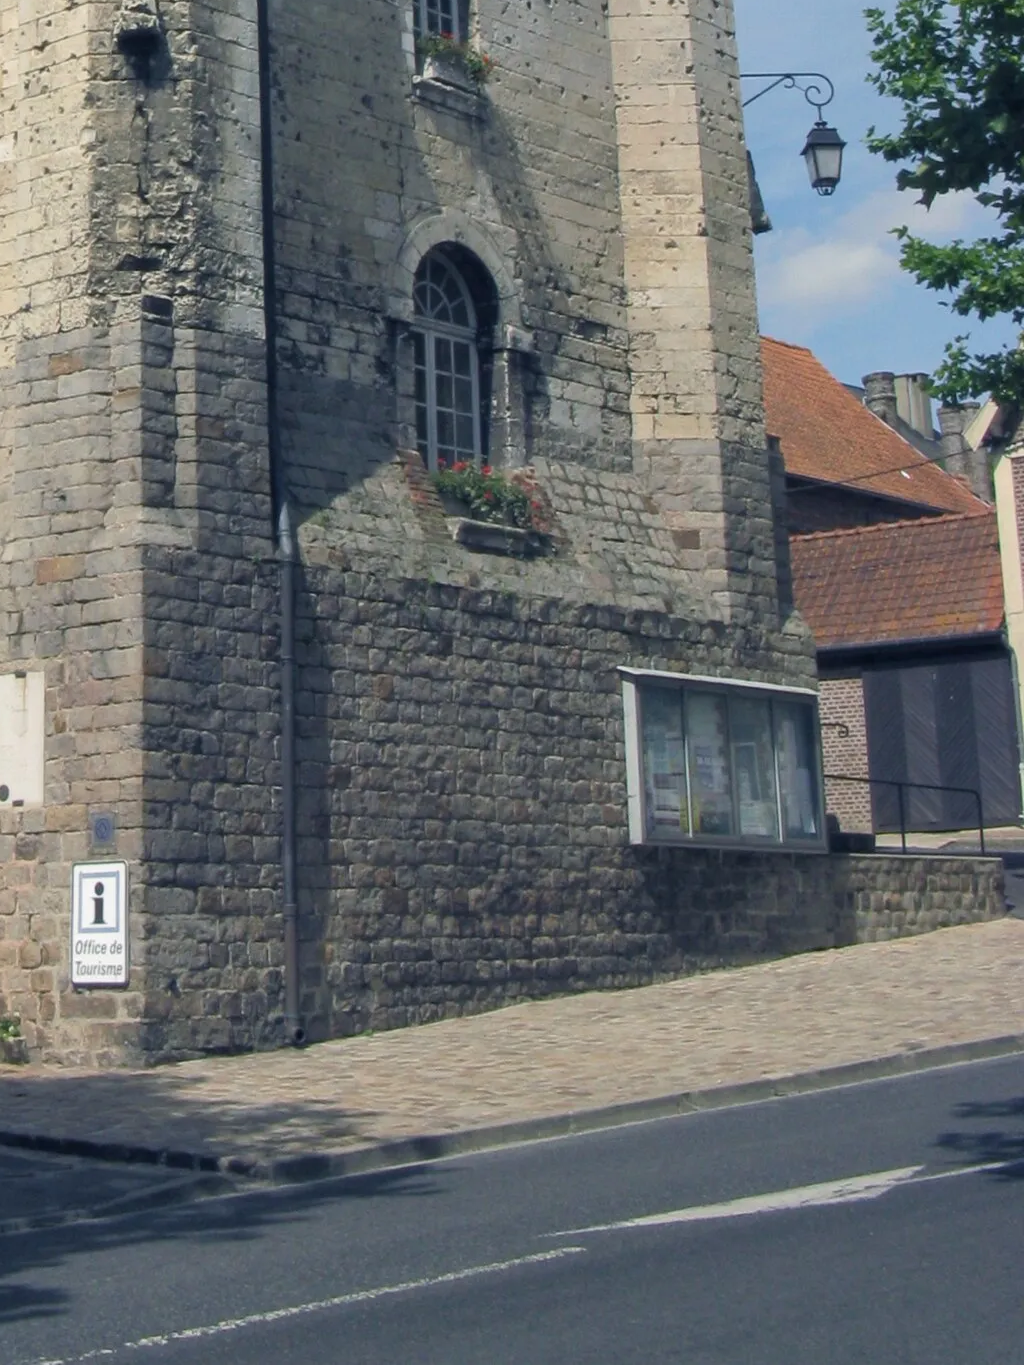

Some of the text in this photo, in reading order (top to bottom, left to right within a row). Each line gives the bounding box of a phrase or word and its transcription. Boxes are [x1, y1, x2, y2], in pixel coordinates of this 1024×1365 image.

[75, 939, 123, 955] Office de
[75, 960, 123, 976] Tourisme
